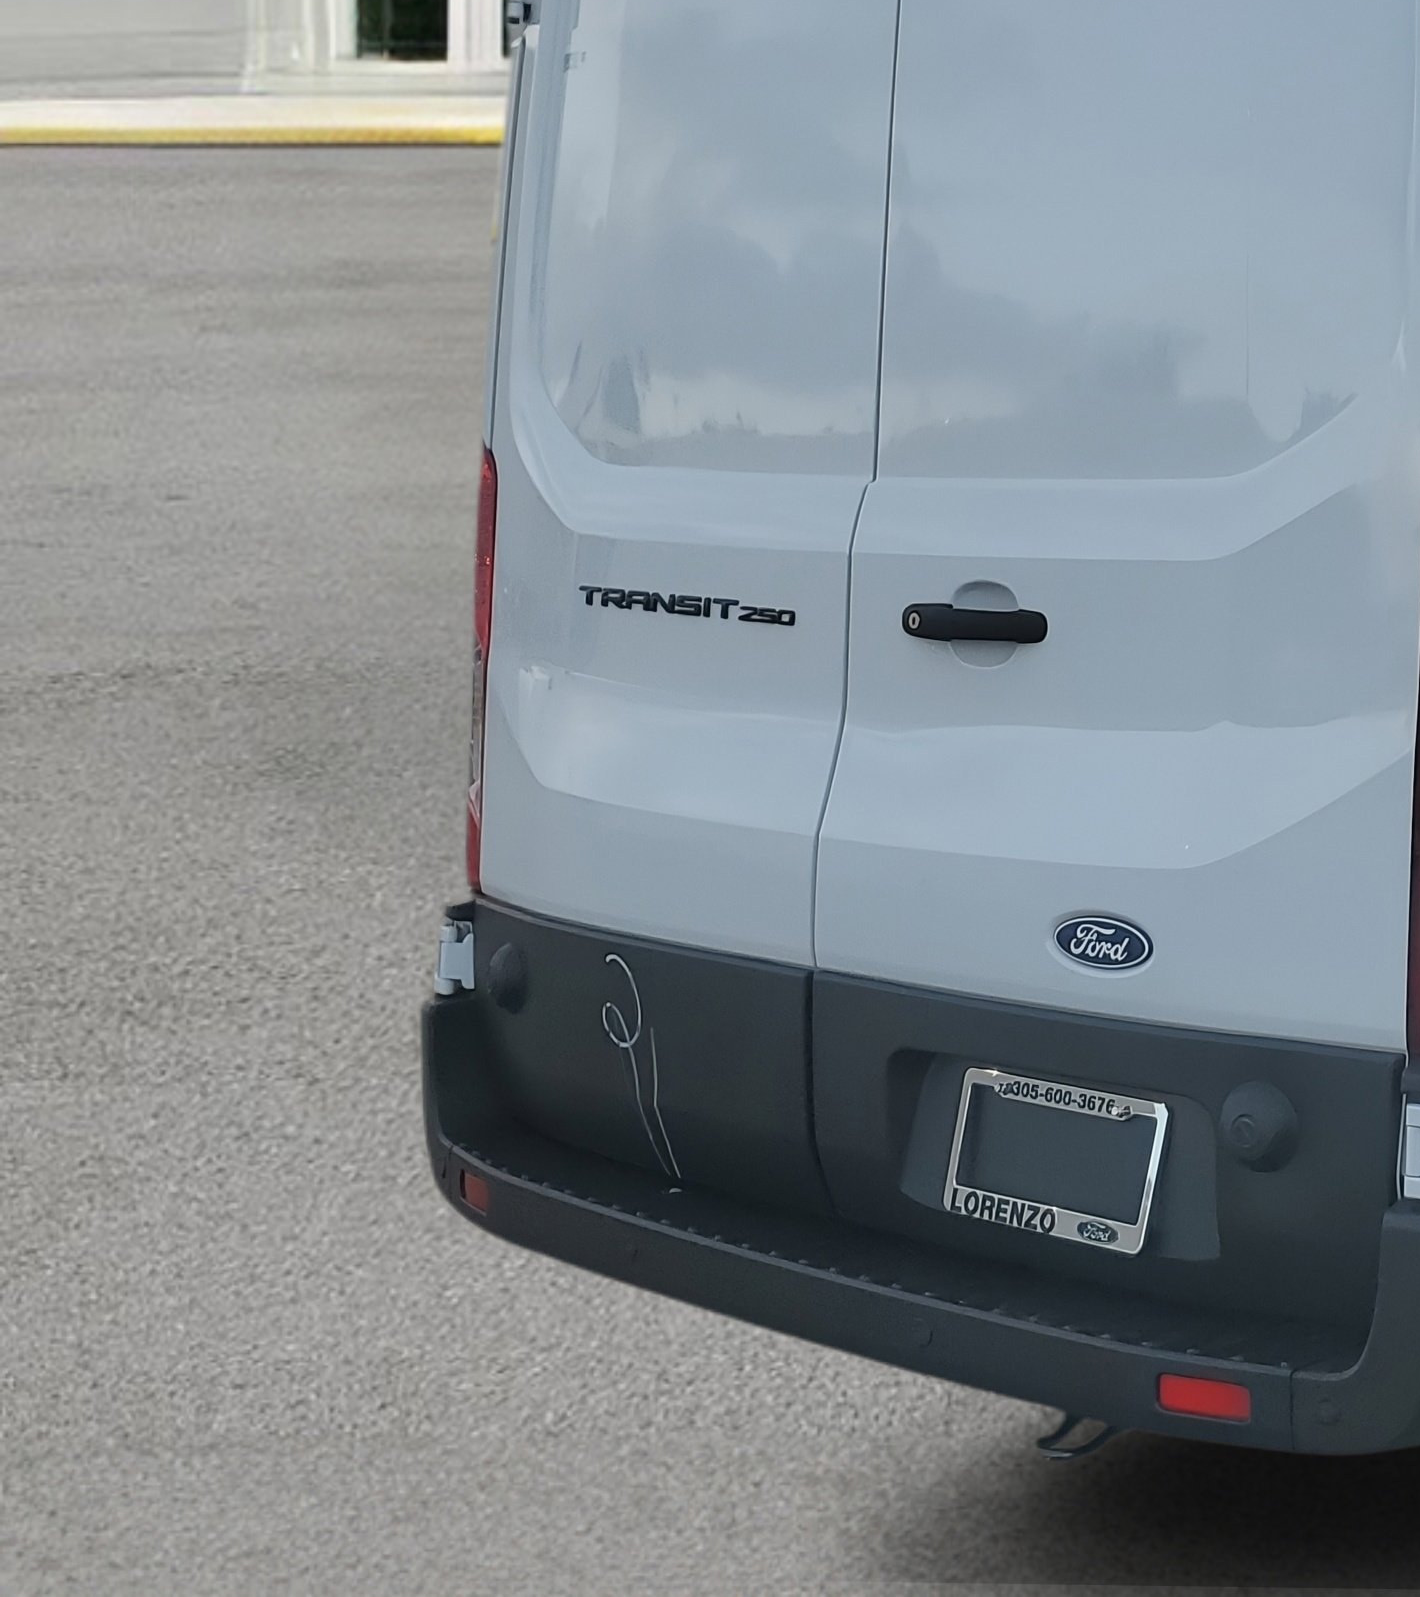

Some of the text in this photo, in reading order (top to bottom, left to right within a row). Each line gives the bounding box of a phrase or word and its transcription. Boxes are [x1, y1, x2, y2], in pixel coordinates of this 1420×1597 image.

[578, 584, 796, 627] TRANSIT 250
[1069, 923, 1130, 962] Ford
[949, 1187, 1056, 1235] LORENZO
